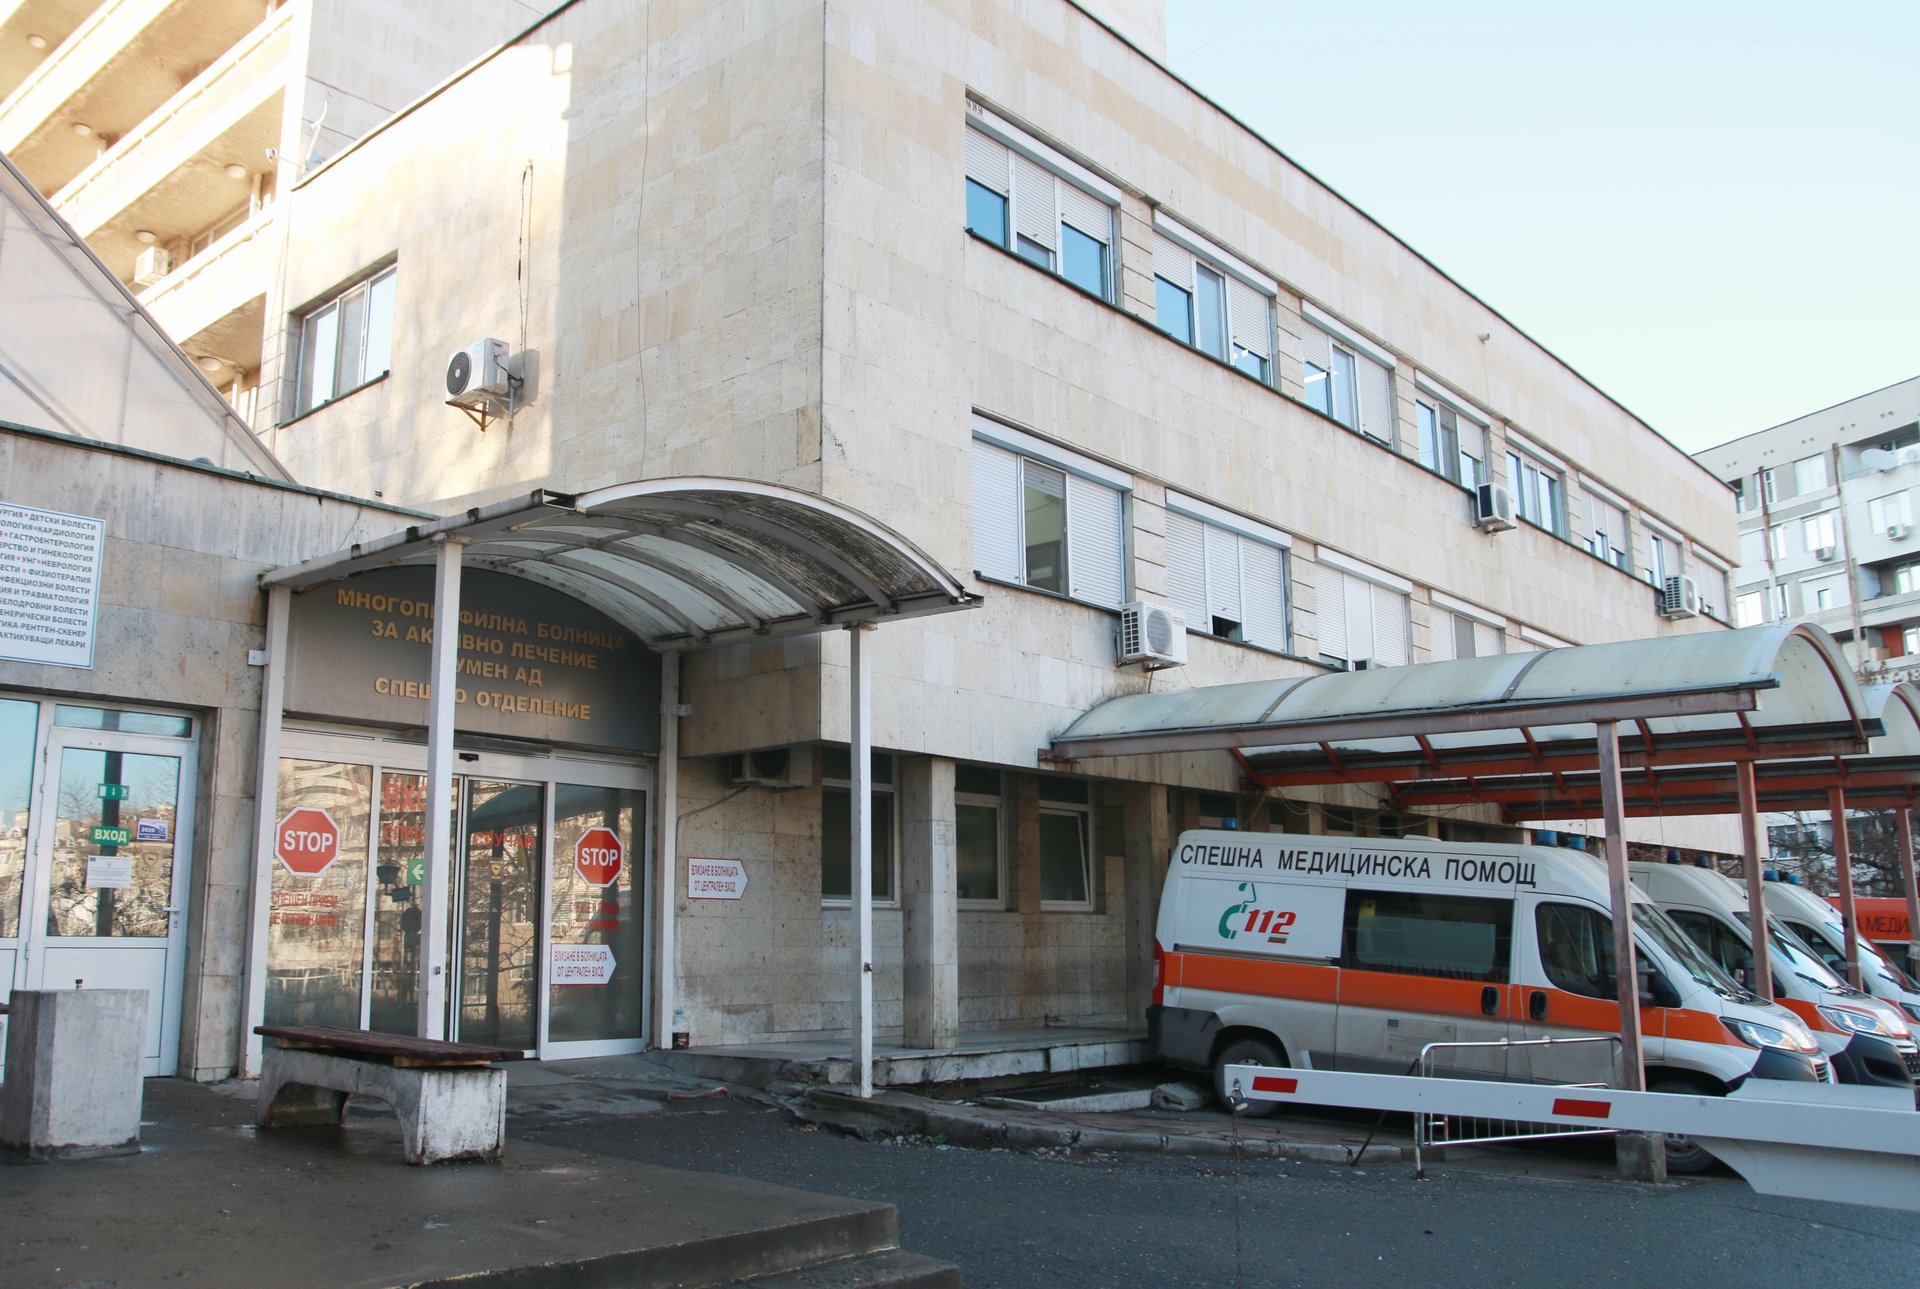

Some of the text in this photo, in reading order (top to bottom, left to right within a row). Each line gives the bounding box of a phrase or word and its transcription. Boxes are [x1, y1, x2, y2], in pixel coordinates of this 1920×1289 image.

[29, 514, 60, 524] ДЕТСКИ
[61, 519, 96, 530] БОЛЕСТИ
[0, 520, 96, 541] ОЛОГИЯ КАРДИОЛОГИЯ
[9, 532, 95, 551] ГАСТРОЕНТЕРОЛОГИЯ
[37, 547, 93, 562] ГИНЕКОЛОГИЯ
[21, 556, 36, 564] УНГ
[41, 560, 93, 573] НЕВРОЛОГИЯ
[28, 568, 92, 584] ФИЗИОТЕРАПИЯ
[21, 589, 89, 605] ТРАВМАТОЛОГИЯ
[55, 584, 90, 595] БОЛЕСТИ
[53, 605, 88, 616] БОЛЕСТИ
[52, 616, 88, 626] БОЛЕСТИ
[337, 588, 625, 651] МНОГОПФИЛНА БОЛНИЦА
[0, 621, 86, 637] ИКА-РЕНТГЕН-СКЕНЕР
[55, 638, 86, 648] ЛЕКАРИ
[371, 620, 598, 669] ЗА АКВНО ЛЕЧЕНИЕ
[456, 658, 543, 687] УМЕН АД
[374, 677, 591, 719] СПЕШО ОТДЕЛЕНИЕ
[94, 829, 127, 842] ВХОД
[284, 830, 333, 852] STOP
[581, 847, 619, 866] STOP
[1180, 844, 1537, 889] СПЕШНА МЕДИЦИНСКА ПОМОЩ
[1244, 909, 1297, 935] 112
[1866, 917, 1911, 934] МЕДИ
[581, 951, 608, 962] БОЛНИЦАТА
[557, 966, 564, 977] ОТ
[565, 966, 592, 978] ЦЕНТРАЛЕН
